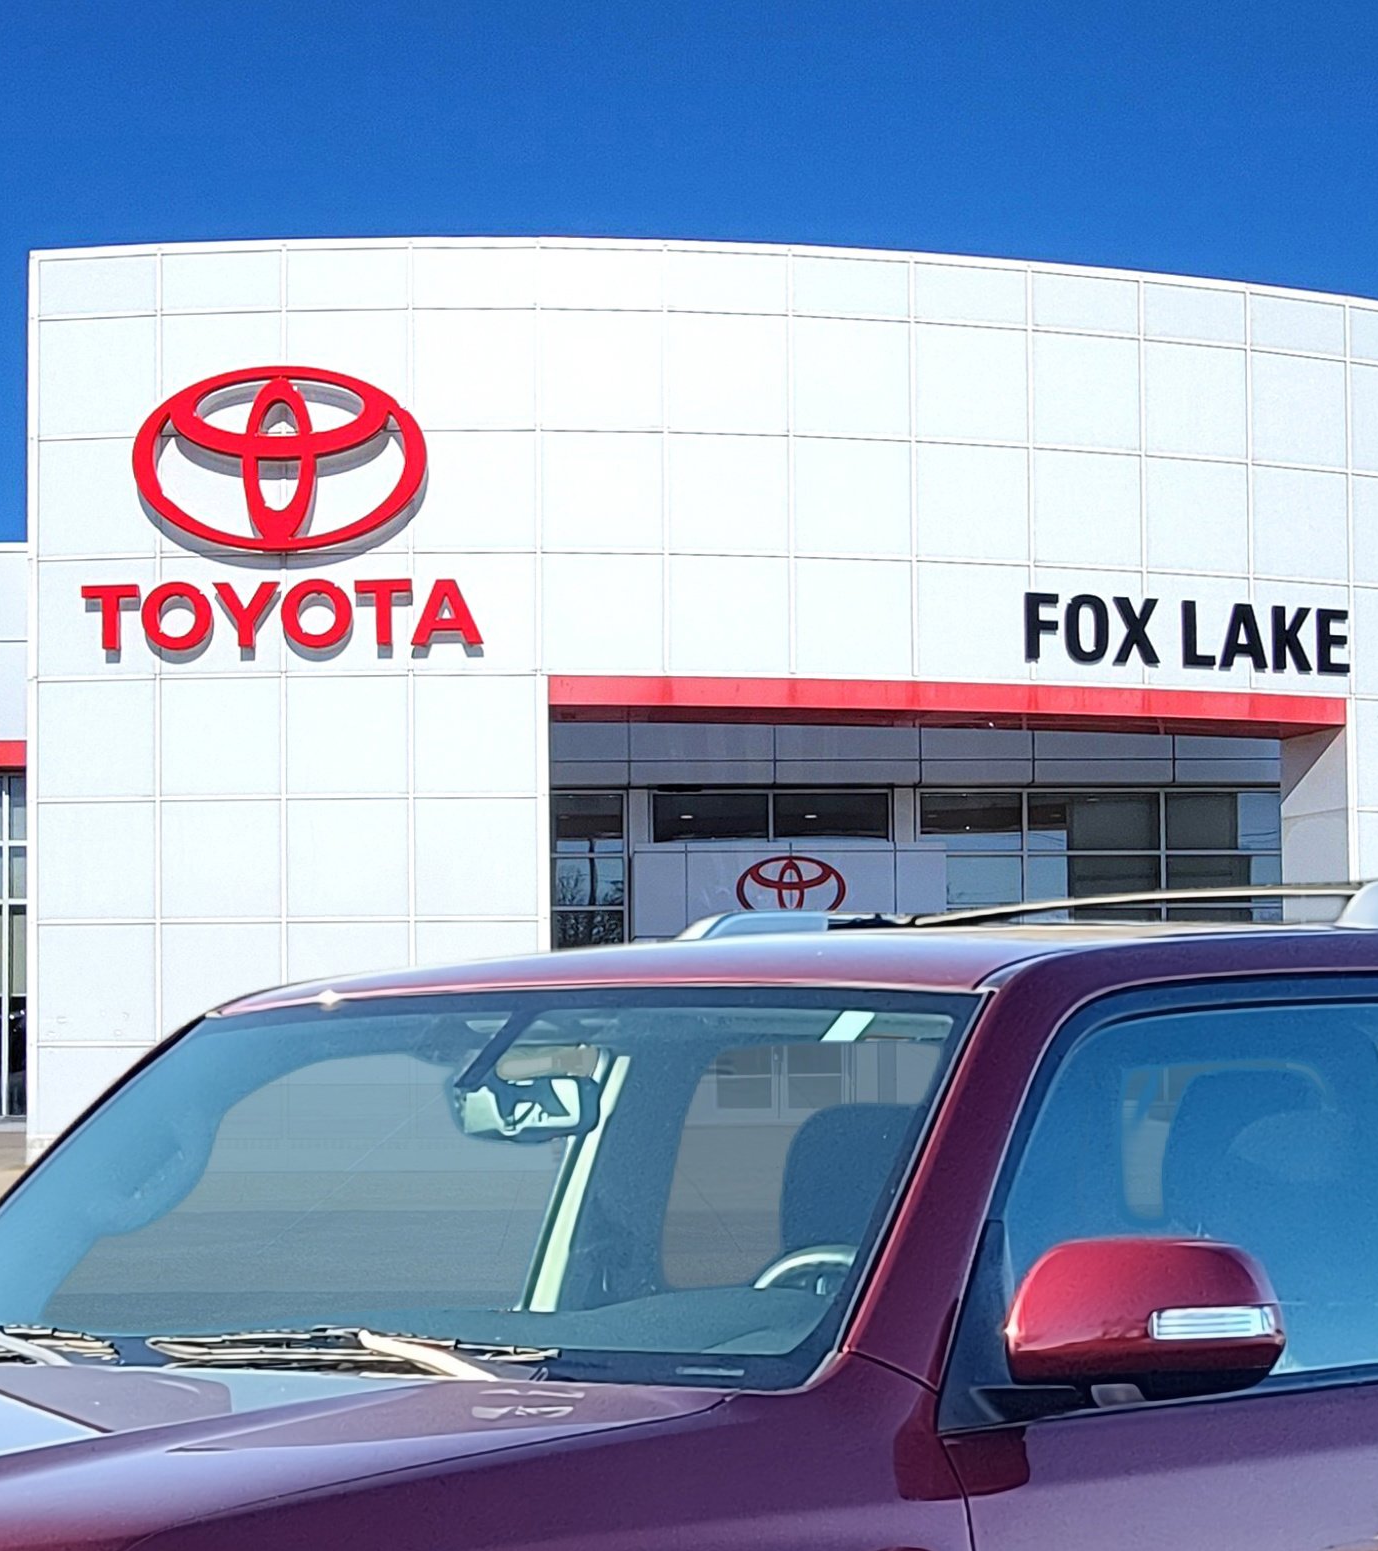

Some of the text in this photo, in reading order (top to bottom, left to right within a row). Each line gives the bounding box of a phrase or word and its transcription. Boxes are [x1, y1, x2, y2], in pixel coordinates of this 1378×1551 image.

[81, 578, 484, 652] TOYOTA
[1023, 591, 1351, 676] FOX LAKE
